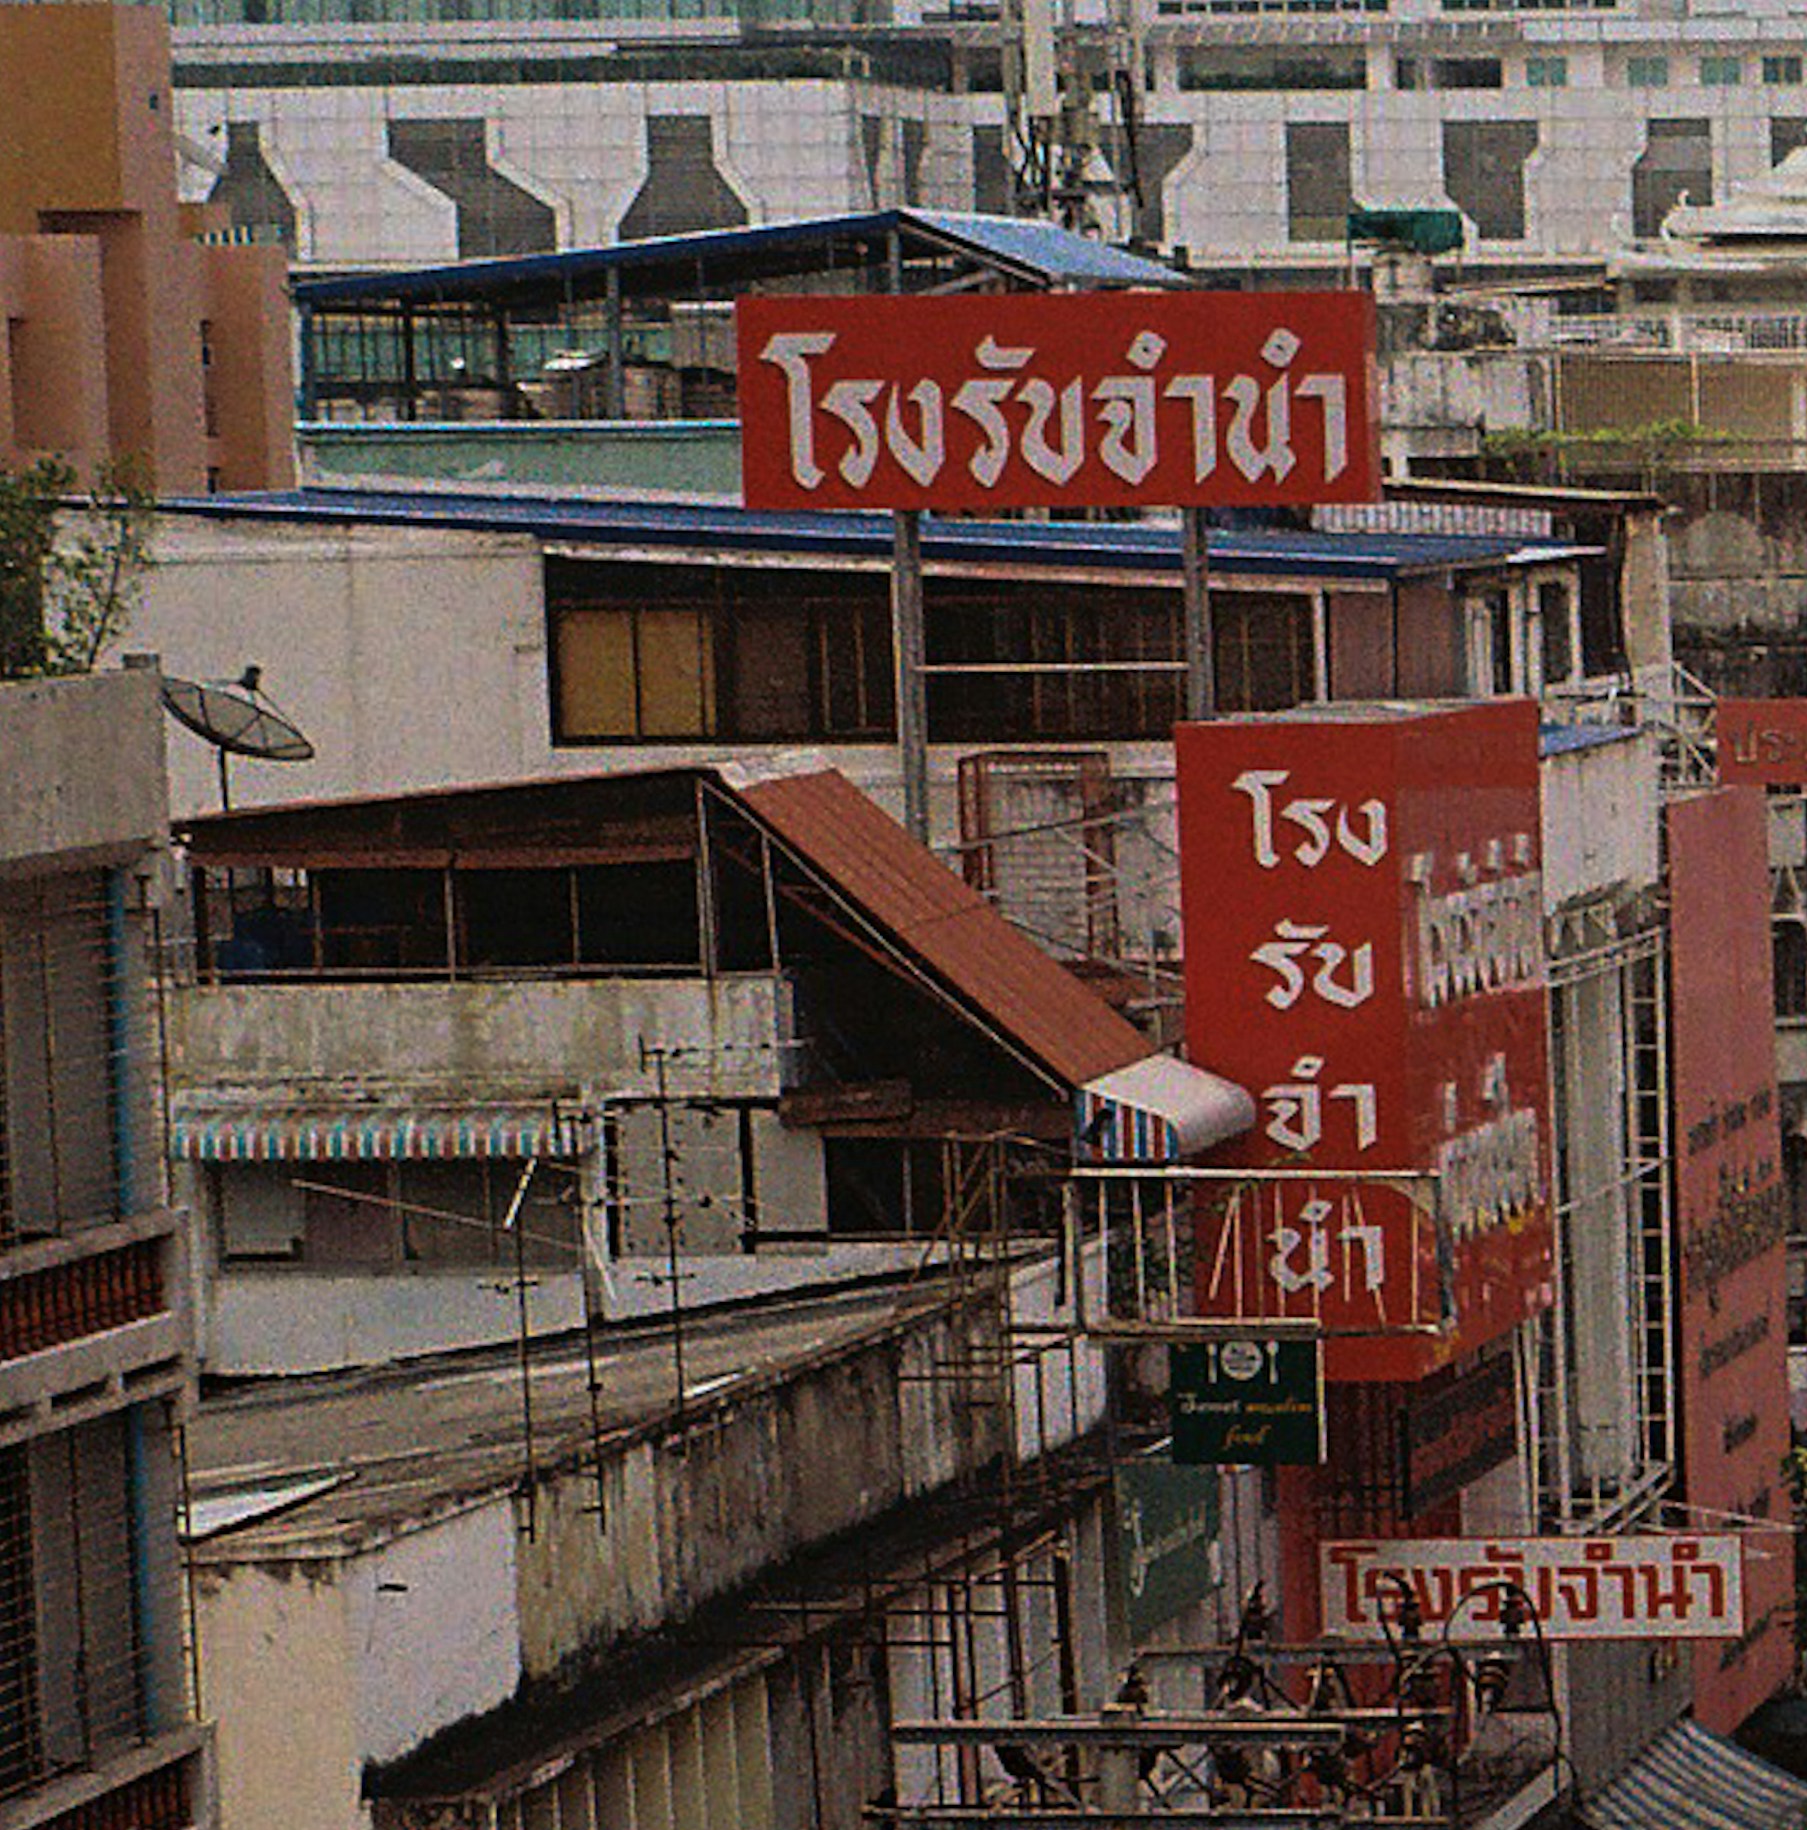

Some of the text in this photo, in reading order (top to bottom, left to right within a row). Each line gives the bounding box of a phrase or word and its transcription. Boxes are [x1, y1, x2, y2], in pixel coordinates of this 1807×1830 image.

[757, 327, 1348, 490] โรงรับจำนำ
[1232, 769, 1389, 869] โรง
[1249, 917, 1375, 1010] รับ
[1261, 1054, 1378, 1152] จำ
[1266, 1200, 1384, 1294] นำ
[1329, 1543, 1725, 1624] โรงรับจำนำ
